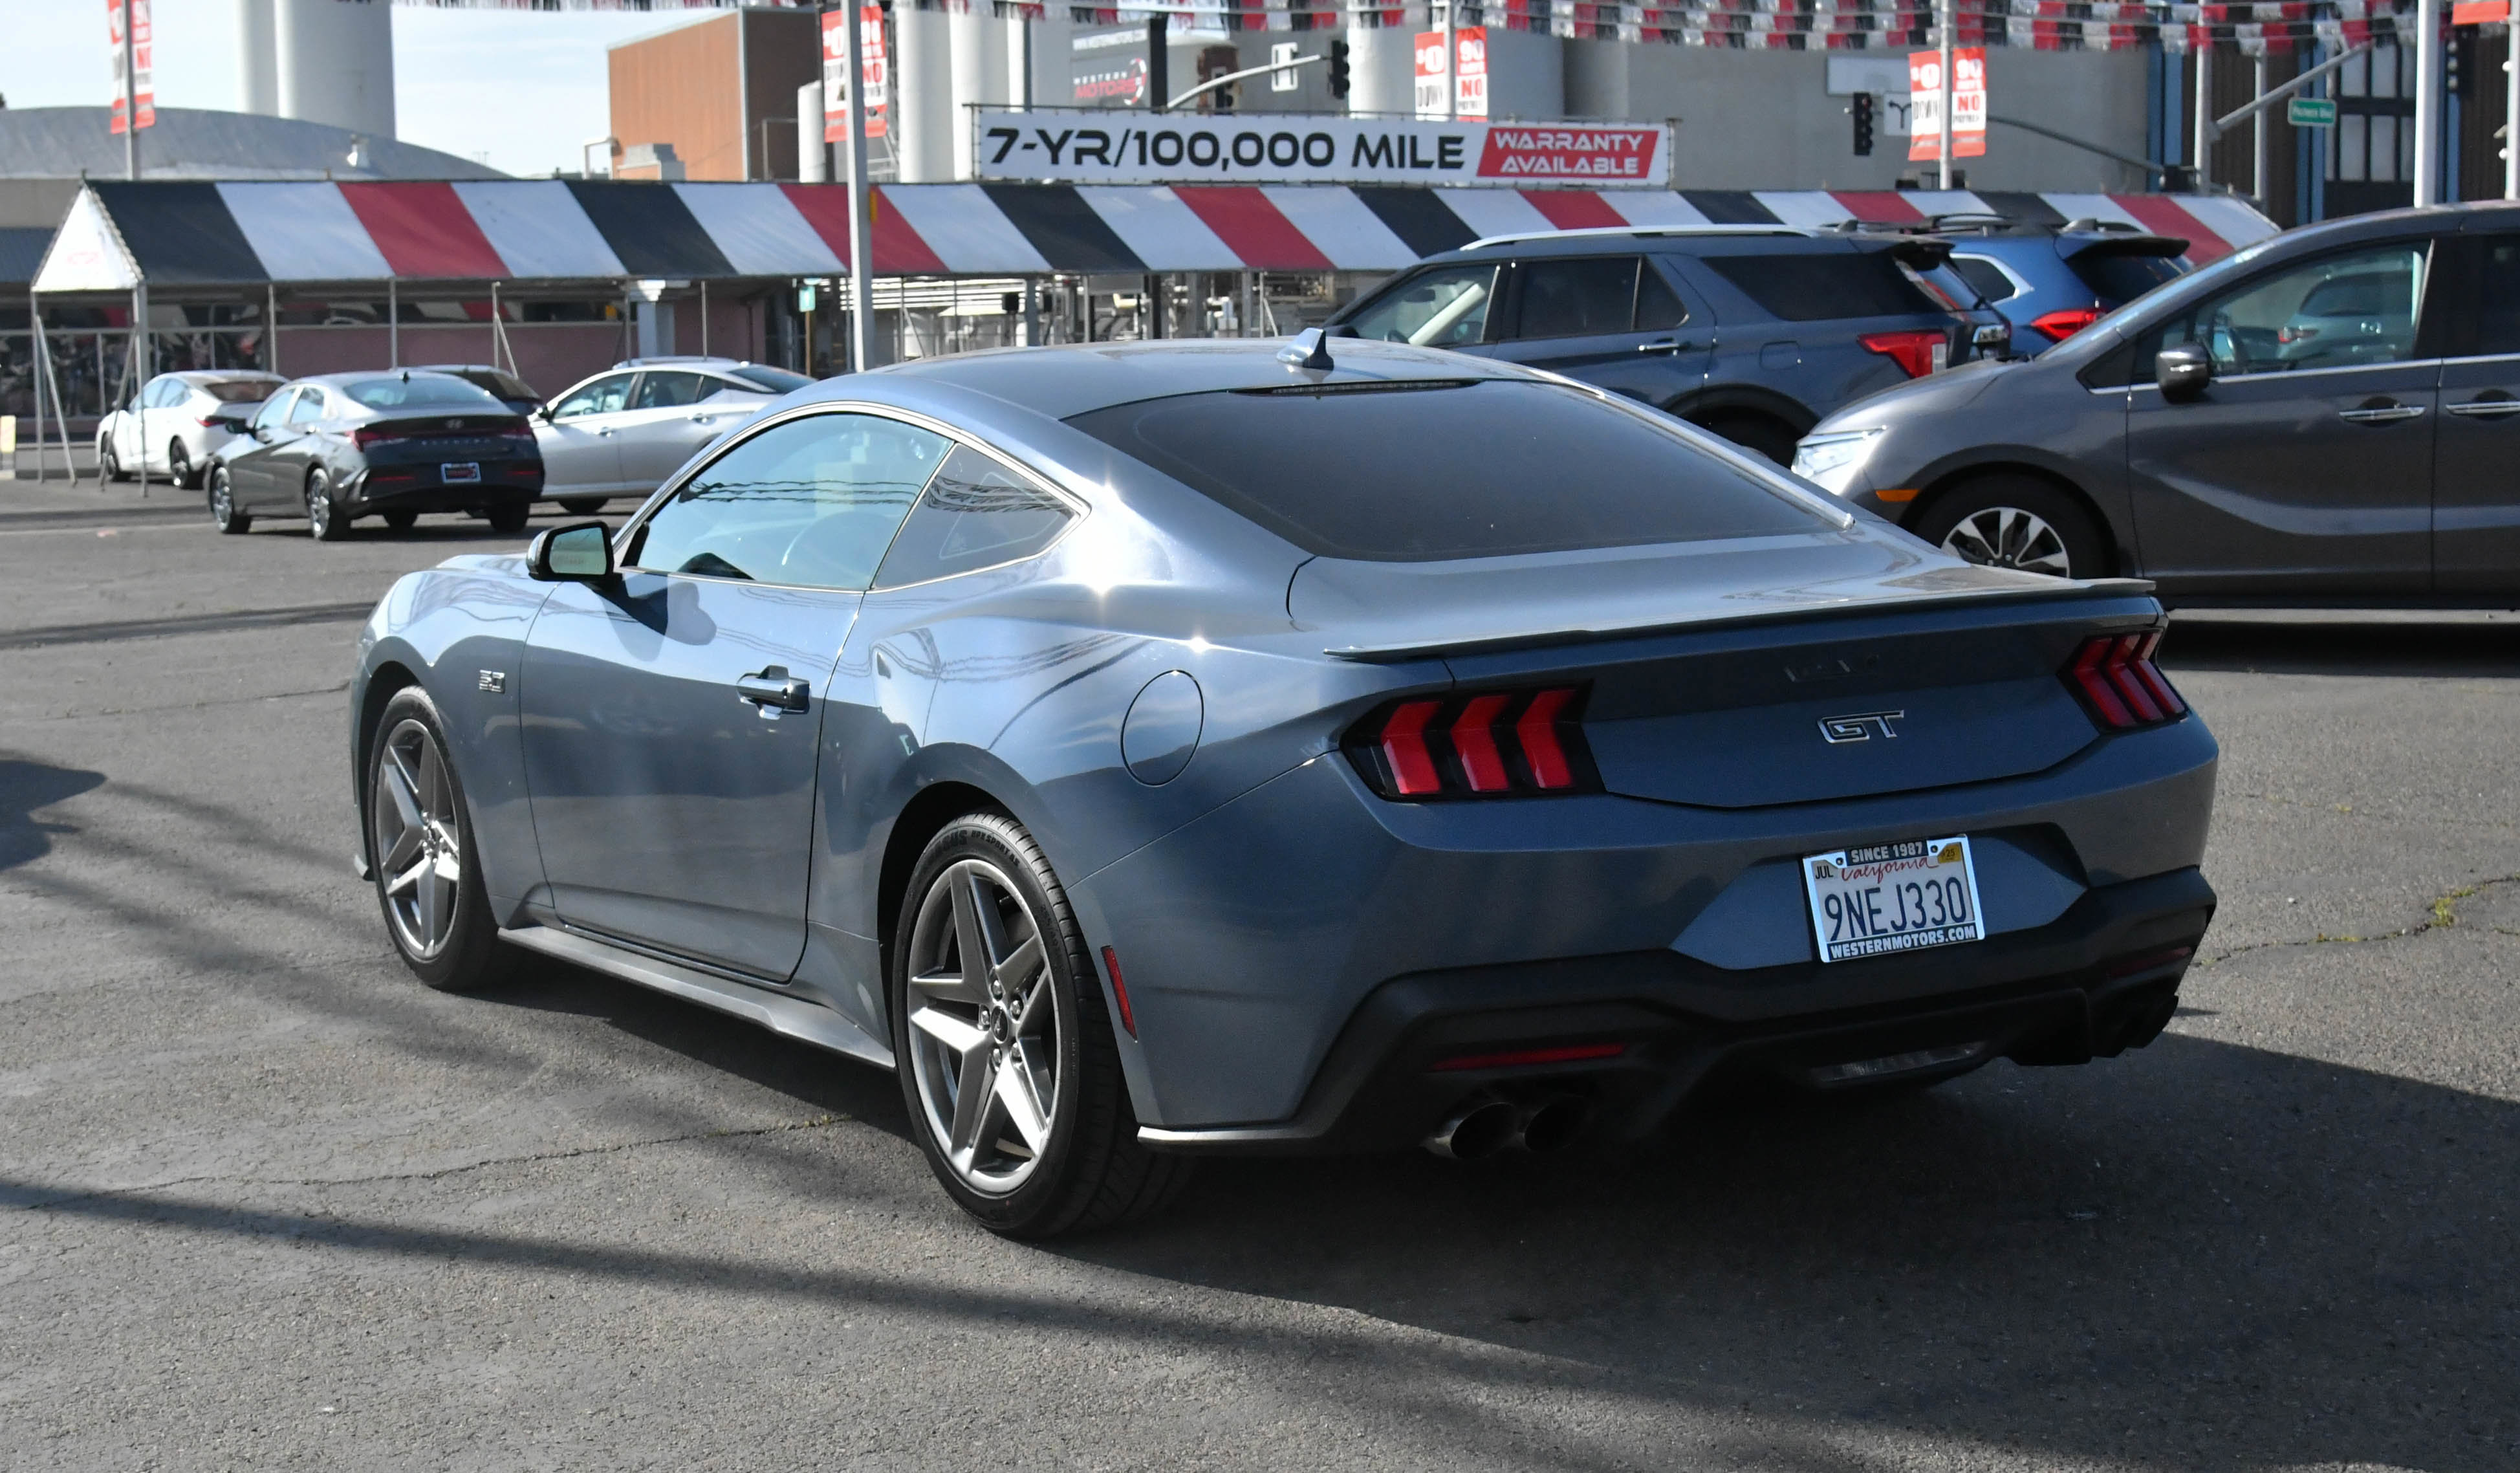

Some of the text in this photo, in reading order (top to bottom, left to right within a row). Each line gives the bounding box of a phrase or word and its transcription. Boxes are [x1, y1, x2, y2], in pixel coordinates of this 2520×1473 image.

[1075, 77, 1137, 98] MOTORS
[1461, 79, 1483, 97] NO
[1958, 95, 1980, 112] NO
[986, 127, 1465, 172] 7-YR/100,000 MILE
[1494, 131, 1644, 152] WARRANTY
[1500, 155, 1639, 175] AVAILABLE
[1817, 710, 1905, 743] GT
[1851, 841, 1924, 863] SINCE 1987
[1815, 865, 1834, 880] JUL
[1841, 856, 1940, 884] California
[1824, 876, 1967, 942] 9NEJ330
[1830, 924, 1976, 959] WESTERNMOTORS.COM
